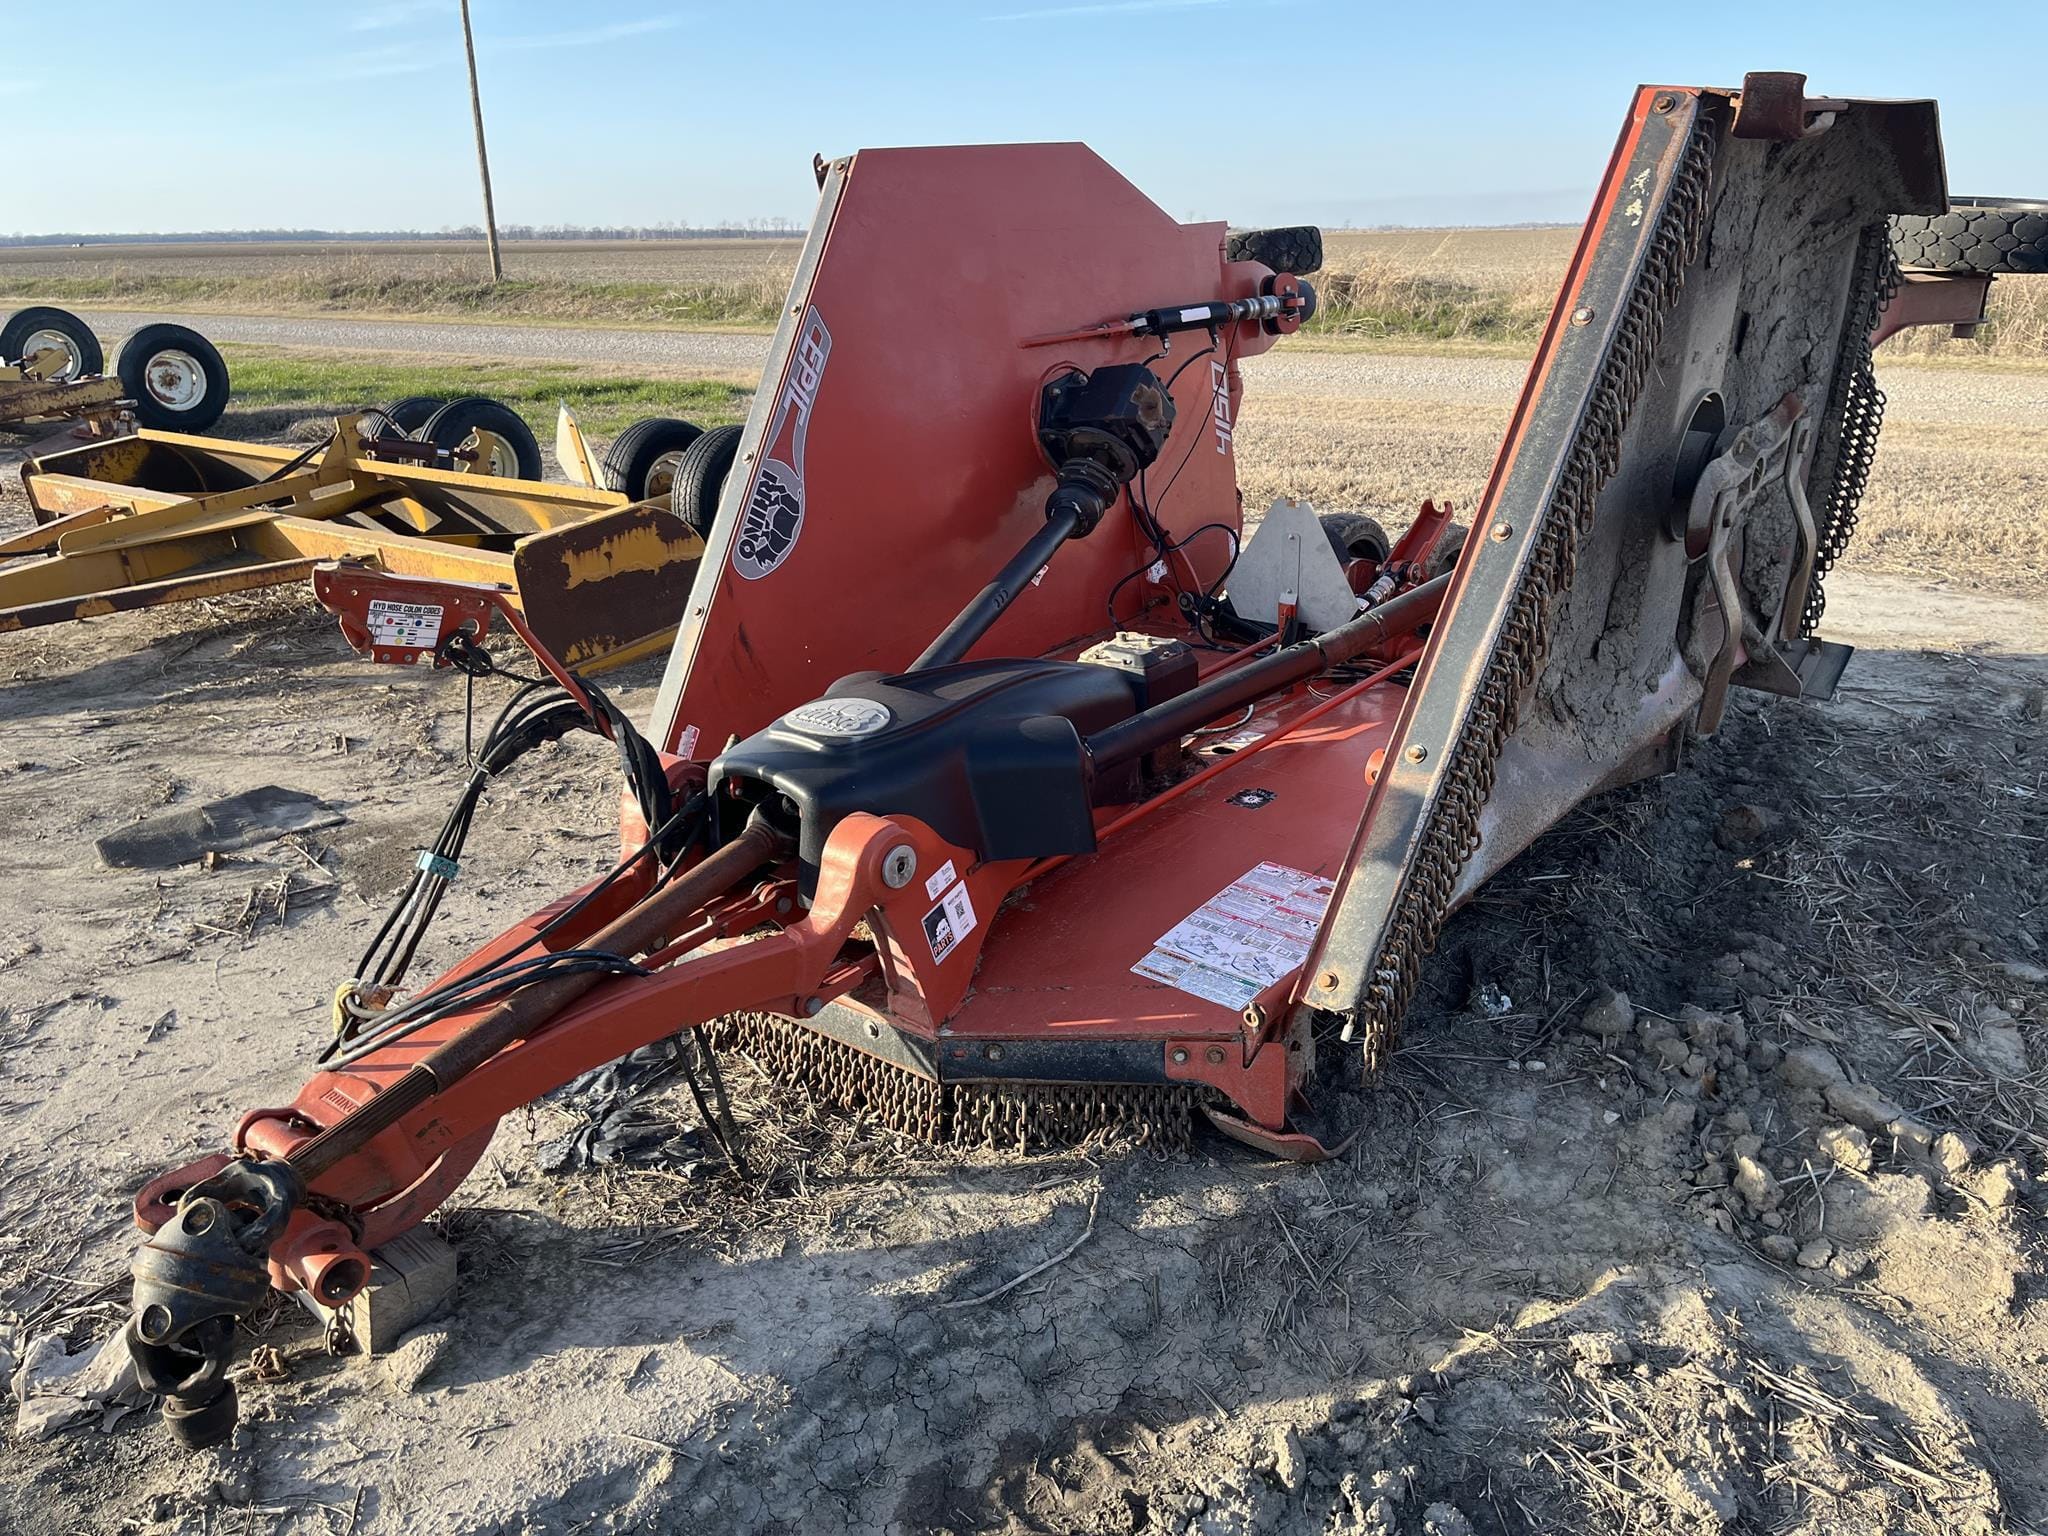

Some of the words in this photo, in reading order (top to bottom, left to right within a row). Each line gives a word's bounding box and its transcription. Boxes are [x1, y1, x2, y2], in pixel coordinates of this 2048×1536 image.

[783, 332, 825, 426] EPIC
[1210, 360, 1232, 455] 4150
[738, 468, 782, 561] RHINO
[373, 601, 386, 610] HYD
[386, 603, 403, 612] HOSE
[403, 605, 422, 614] COLOR
[423, 606, 441, 615] CODES
[933, 931, 954, 956] PARTS
